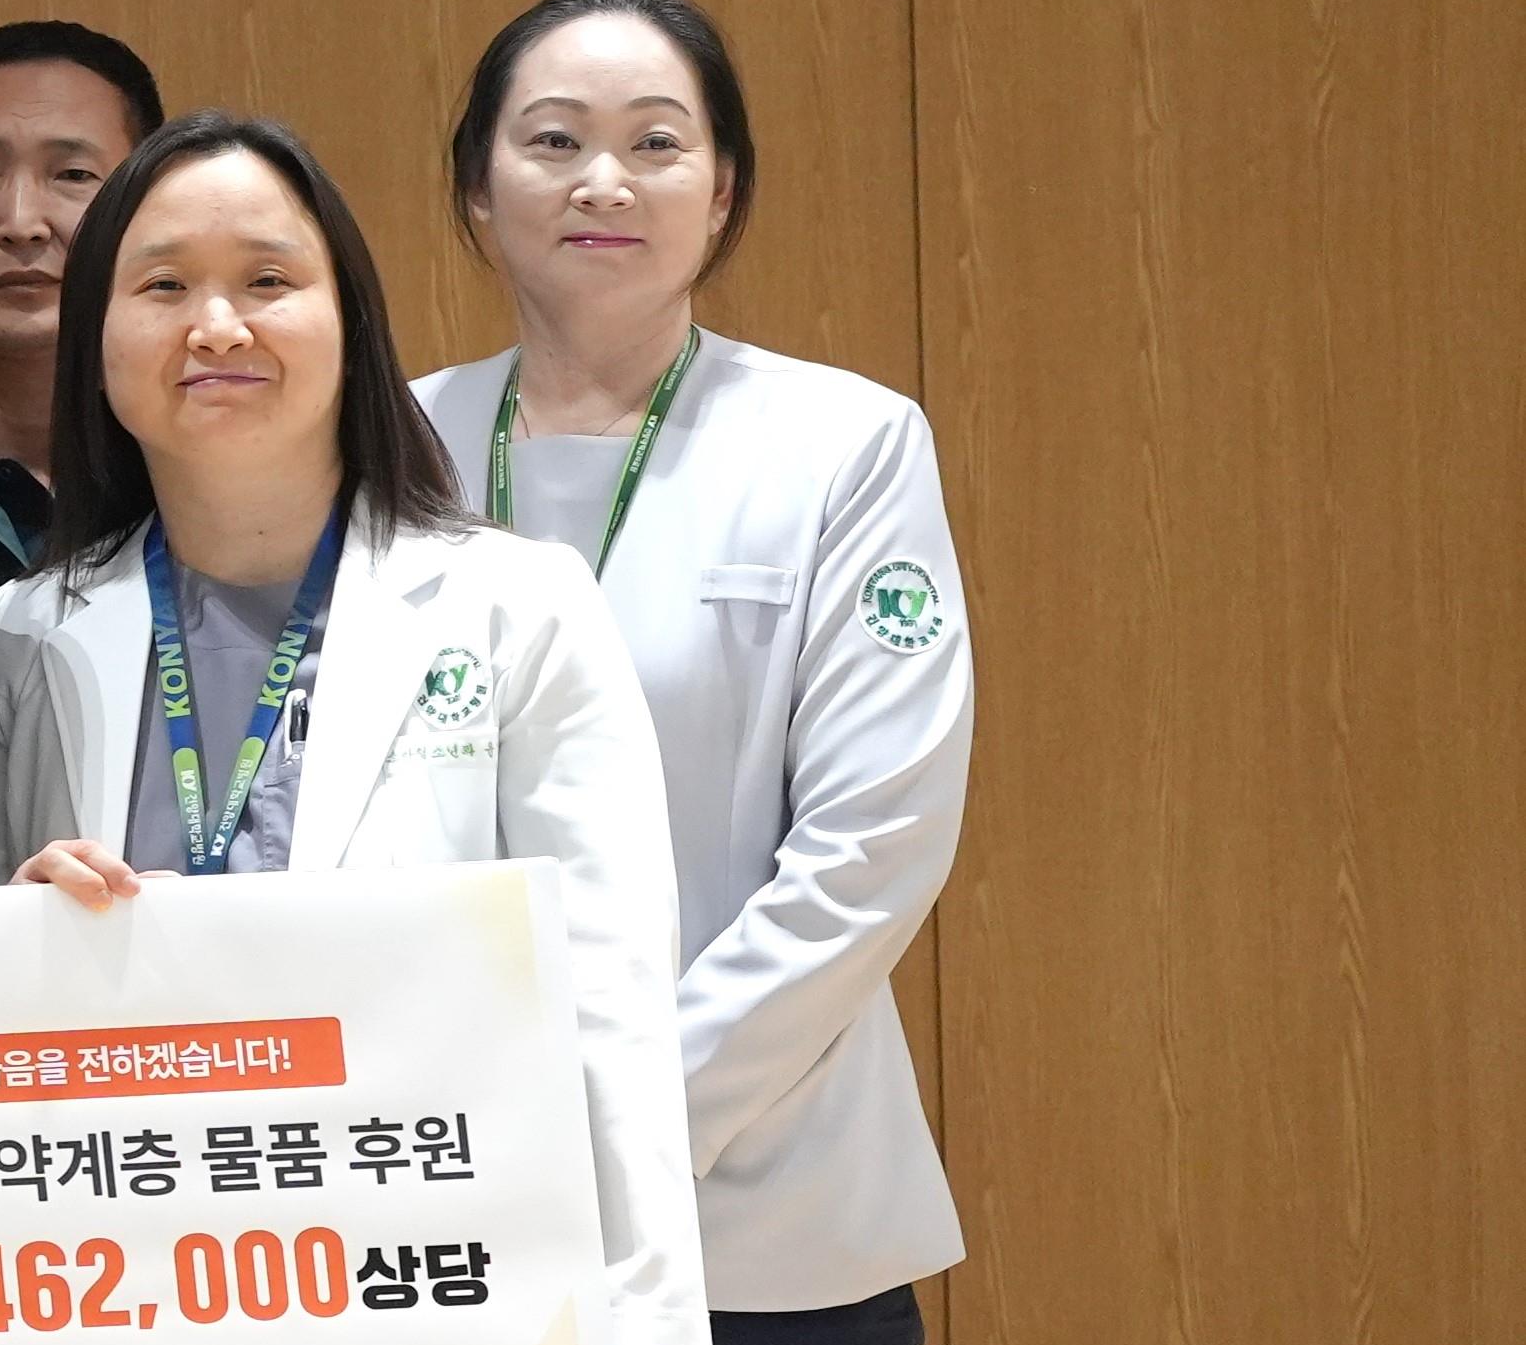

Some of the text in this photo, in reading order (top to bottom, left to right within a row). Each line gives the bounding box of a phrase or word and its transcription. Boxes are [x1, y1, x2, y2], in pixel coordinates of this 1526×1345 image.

[79, 1039, 292, 1085] 전하겠습니다!
[201, 1122, 327, 1192] 물품
[348, 1113, 474, 1184] 후원
